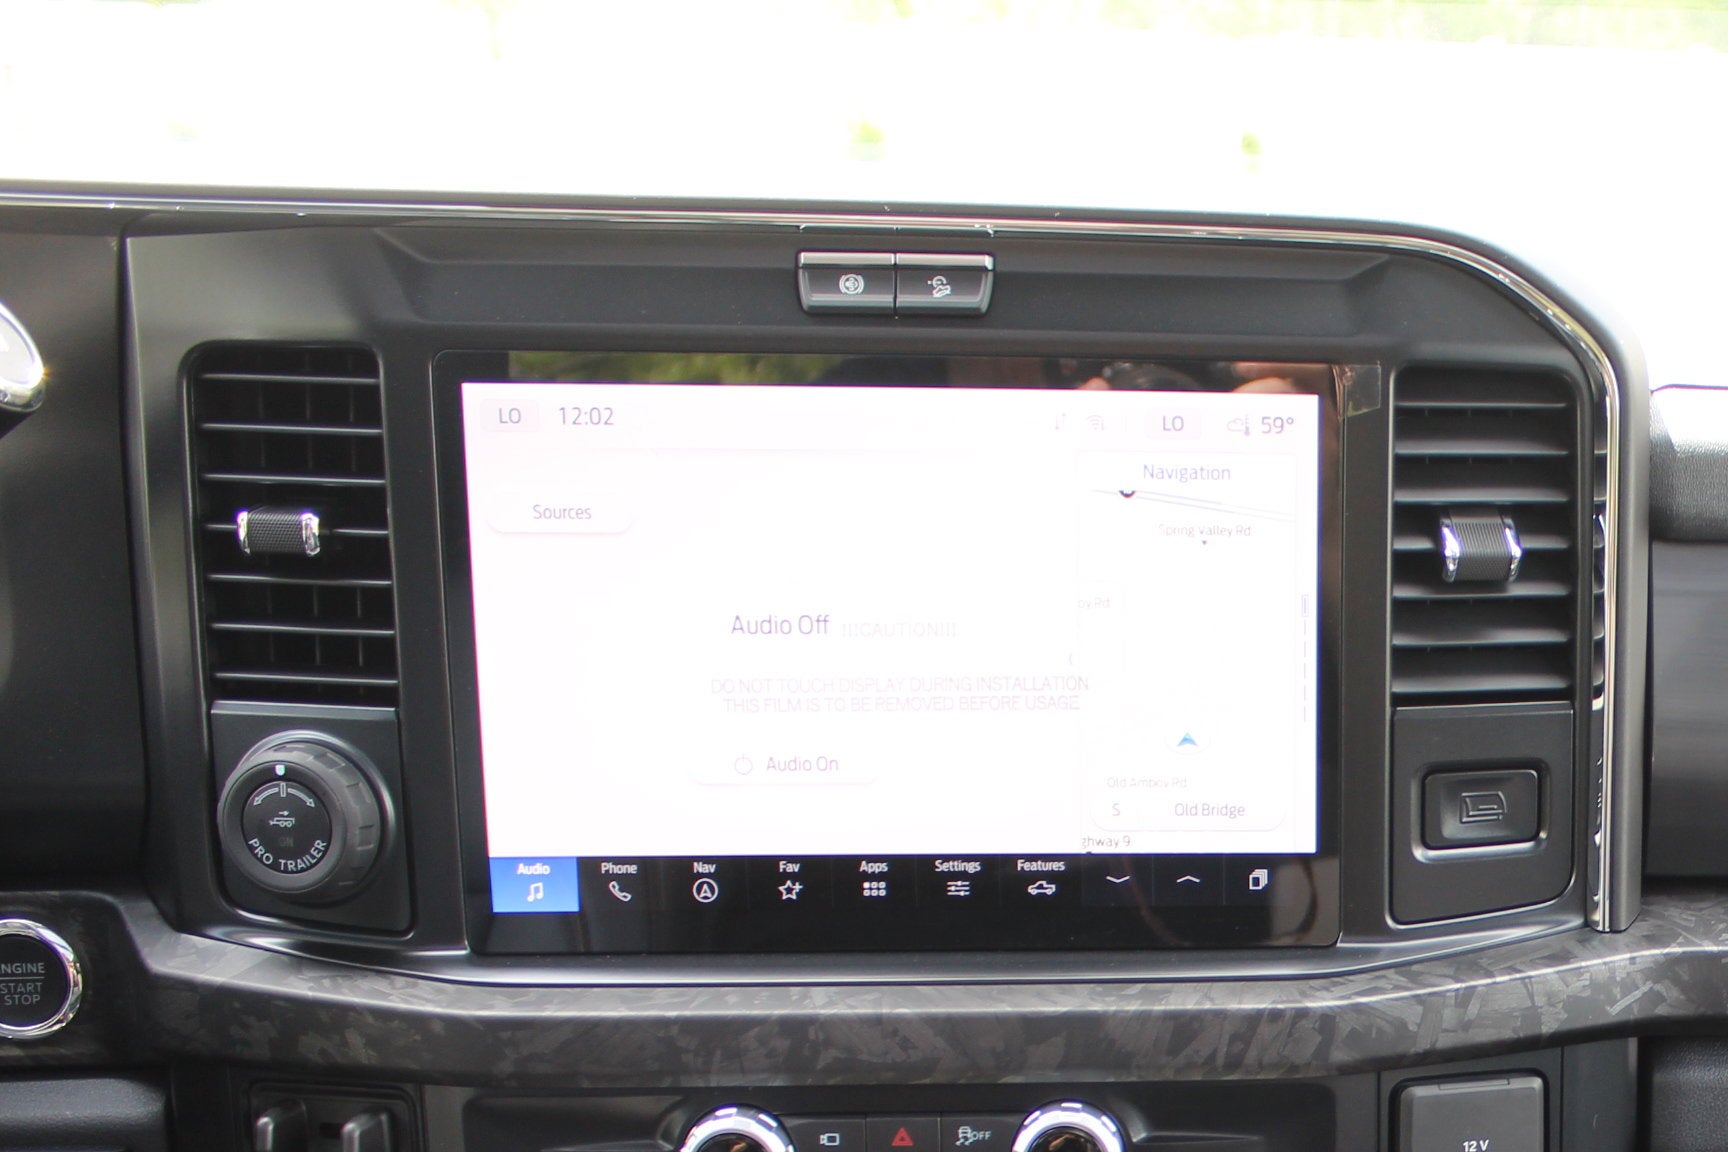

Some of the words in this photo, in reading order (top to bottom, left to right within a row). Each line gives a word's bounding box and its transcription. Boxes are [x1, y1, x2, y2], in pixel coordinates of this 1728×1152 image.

[498, 407, 522, 425] LO
[557, 406, 615, 426] 12:02
[1161, 415, 1185, 432] LO
[1260, 415, 1296, 435] 59°
[1142, 463, 1232, 483] Navigation
[531, 503, 593, 520] Sources
[1198, 525, 1232, 538] Valley
[1235, 525, 1251, 536] Rd
[730, 613, 792, 636] Audio
[797, 613, 831, 636] Off
[711, 678, 735, 695] DO
[739, 678, 774, 694] NOT
[778, 678, 834, 694] TOUCH
[838, 677, 905, 693] DISPLAY
[909, 676, 973, 692] DURING
[976, 675, 1090, 692] INSTALLATION
[723, 697, 760, 713] THIS
[764, 697, 801, 713] FILM
[806, 697, 821, 713] IS
[826, 697, 846, 713] TO
[850, 697, 873, 712] BE
[874, 696, 954, 712] REMOVED
[958, 696, 1021, 711] BEFORE
[1024, 695, 1081, 711] USAGE
[765, 755, 812, 773] Audio
[816, 756, 840, 773] On
[1111, 803, 1121, 817] S
[1174, 802, 1199, 817] Old
[1201, 802, 1246, 820] Bridge
[1122, 835, 1131, 848] 9
[248, 837, 274, 865] PRO
[278, 839, 328, 872] TRAILER
[516, 863, 551, 875] Audio
[601, 862, 638, 875] Phone
[693, 862, 717, 874] Nav
[778, 861, 800, 873] Fav
[859, 861, 889, 876] Apps
[934, 860, 981, 875] Settings
[1016, 859, 1066, 872] Features
[0, 962, 46, 974] NGINE
[0, 982, 43, 994] START
[4, 994, 41, 1006] STOP
[972, 1131, 991, 1141] OFF
